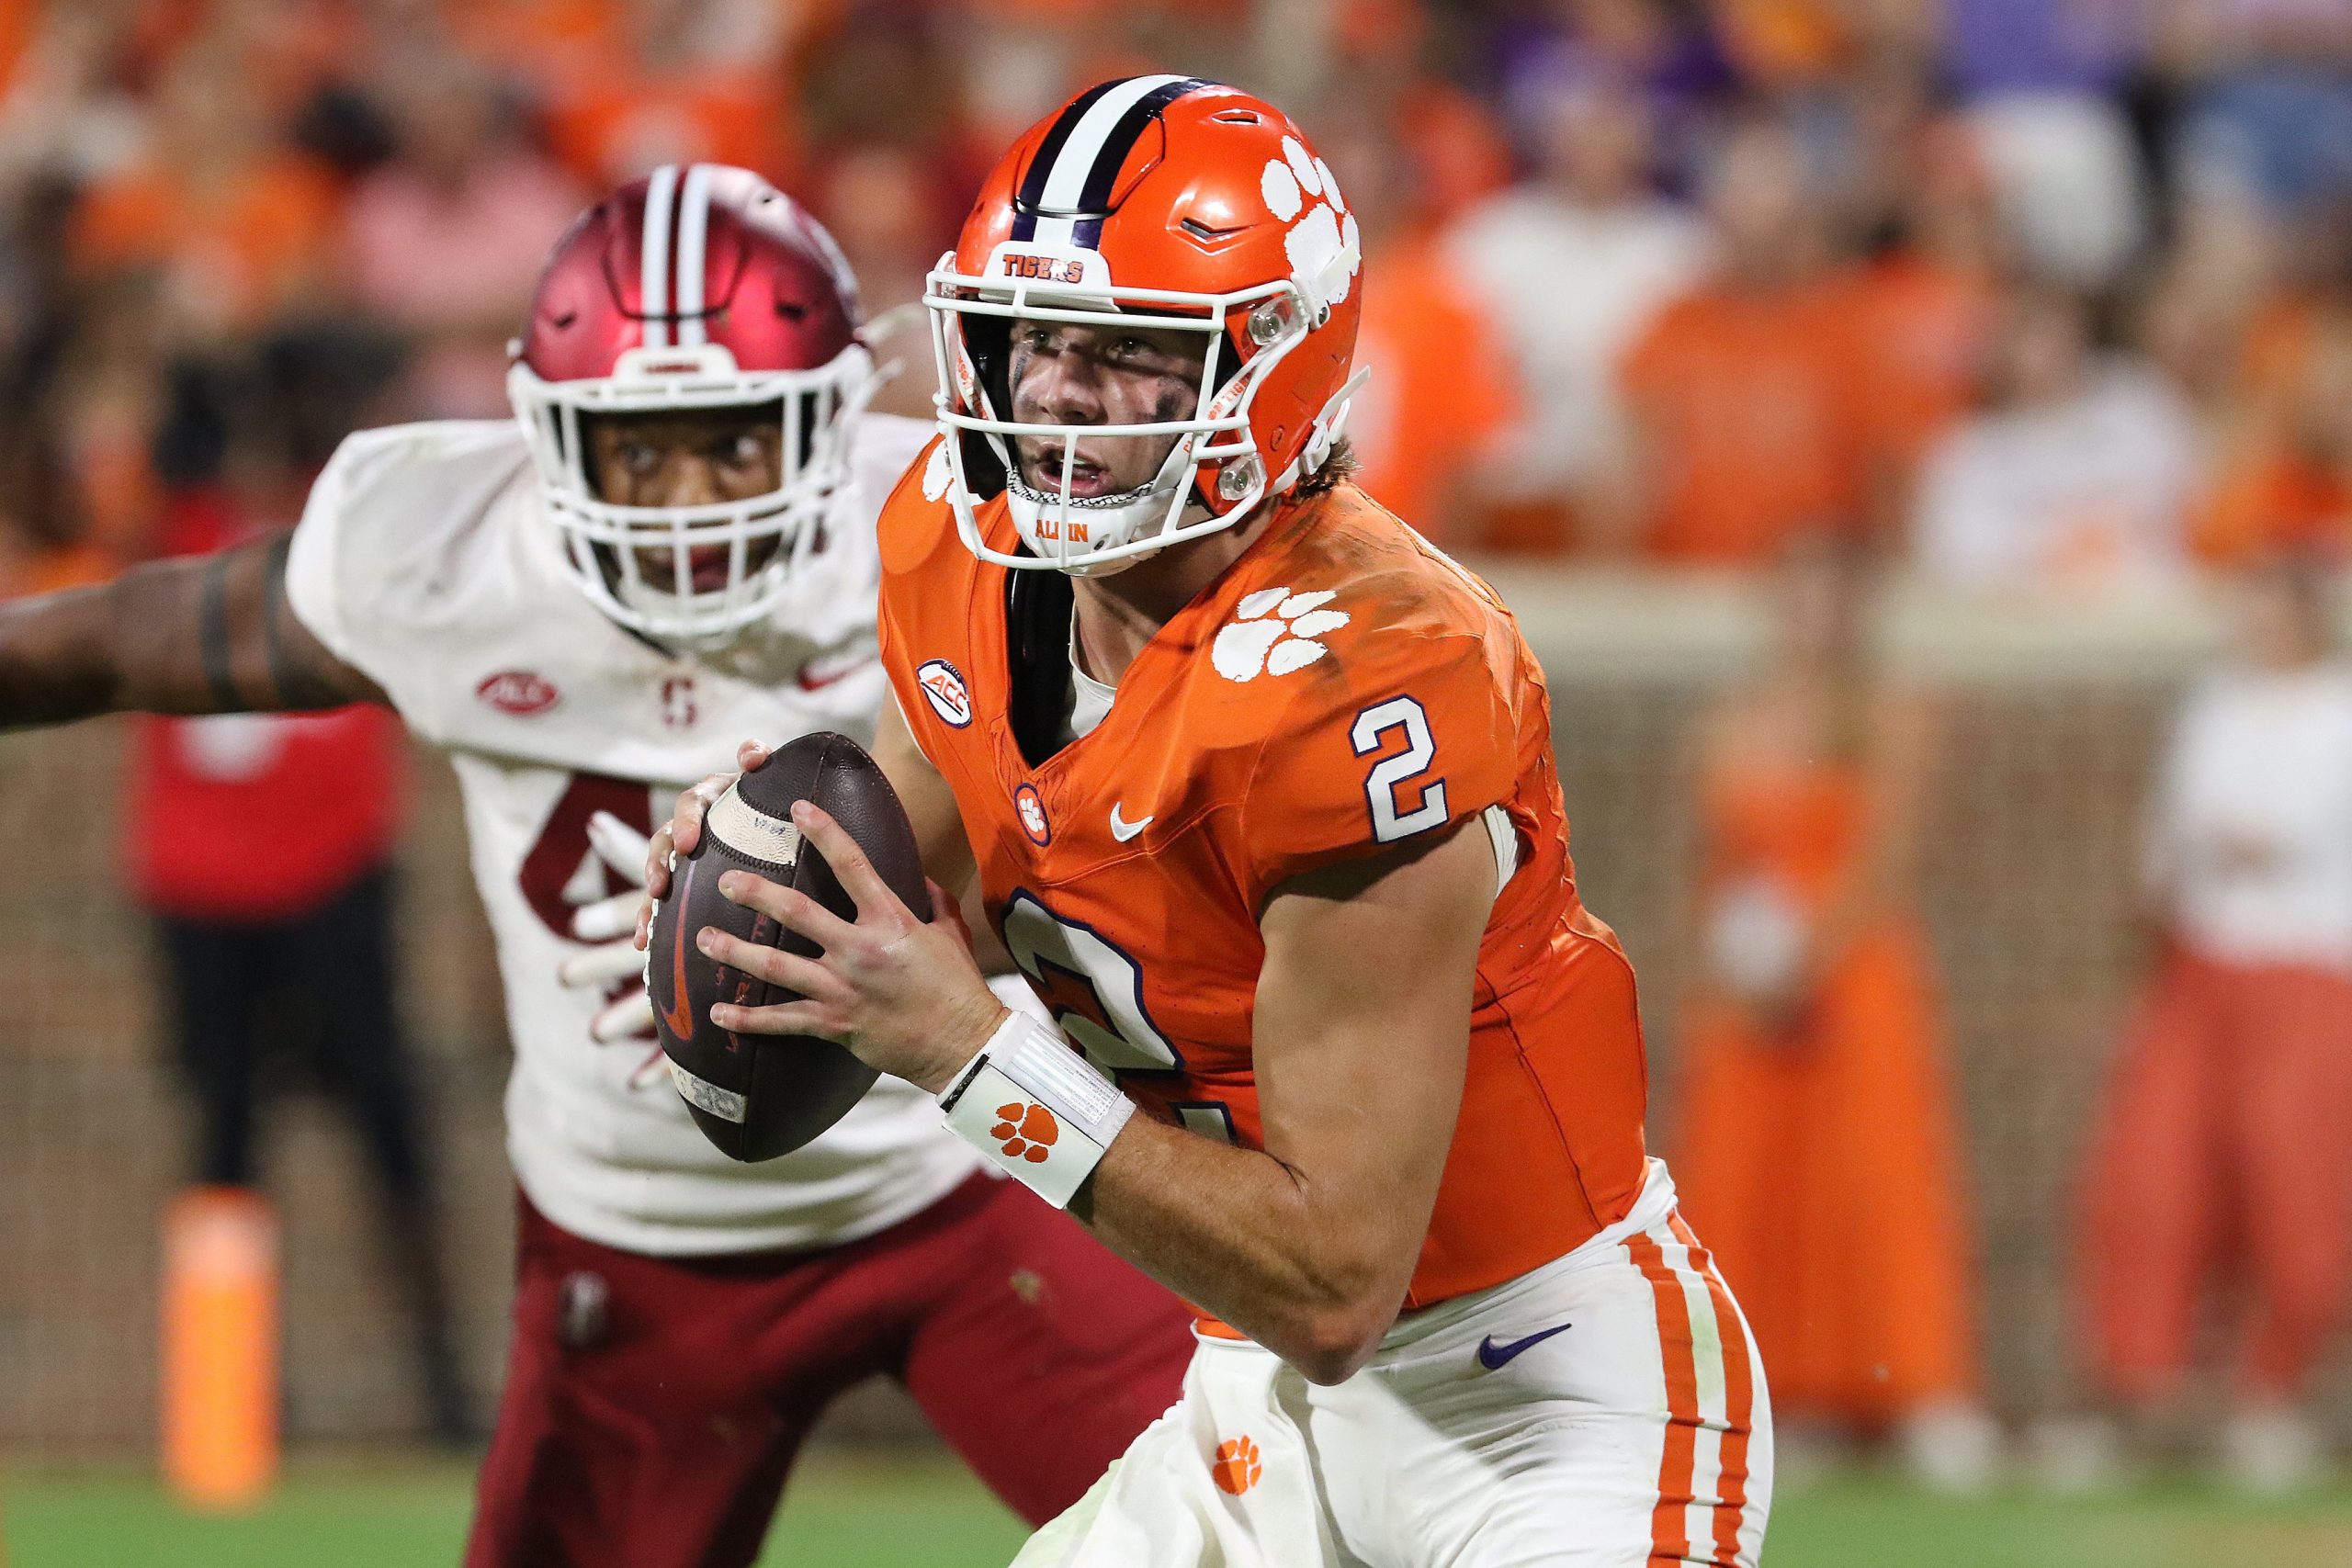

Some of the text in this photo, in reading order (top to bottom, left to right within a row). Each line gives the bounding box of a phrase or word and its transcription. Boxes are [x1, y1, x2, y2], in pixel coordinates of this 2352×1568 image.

[1002, 254, 1084, 285] TIGERS
[925, 674, 967, 713] ACC
[1349, 693, 1451, 845] 2
[1001, 886, 1238, 1147] 2
